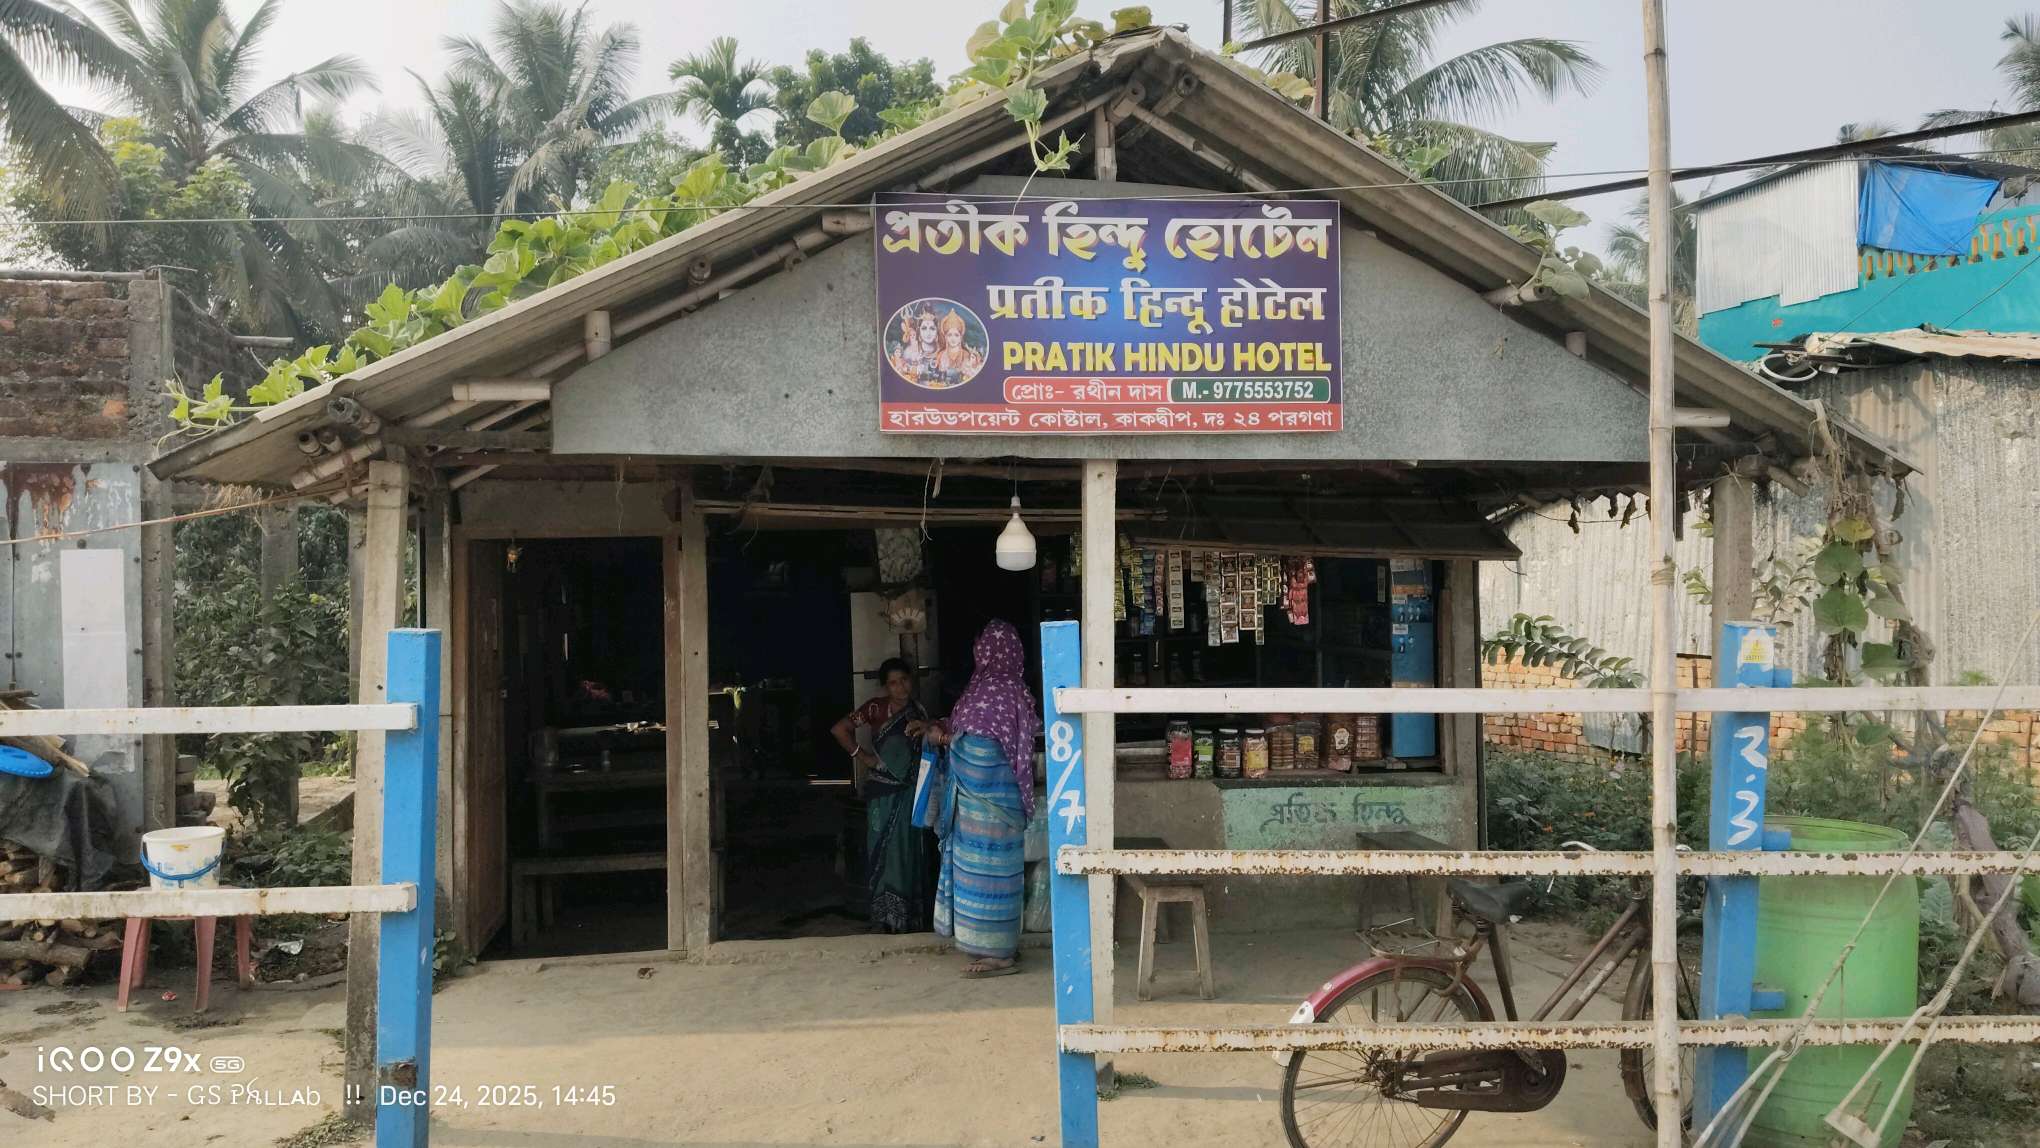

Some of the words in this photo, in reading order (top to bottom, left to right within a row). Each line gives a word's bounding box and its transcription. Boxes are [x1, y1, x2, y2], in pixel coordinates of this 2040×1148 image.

[882, 199, 1031, 257] প্রতীক
[1042, 201, 1149, 273] হিন্দু
[1164, 203, 1333, 261] হোটেল
[986, 276, 1110, 321] प्रतीक
[1120, 277, 1214, 335] हिन्दू
[1217, 278, 1328, 328] होटेल
[1002, 341, 1116, 372] PRATIK
[1124, 342, 1226, 372] HINDU
[1233, 343, 1332, 372] HOTEL
[1070, 379, 1122, 401] রথীন
[1127, 383, 1163, 401] দাস
[1213, 381, 1314, 399] 9775553752
[1233, 412, 1261, 427] ২৪
